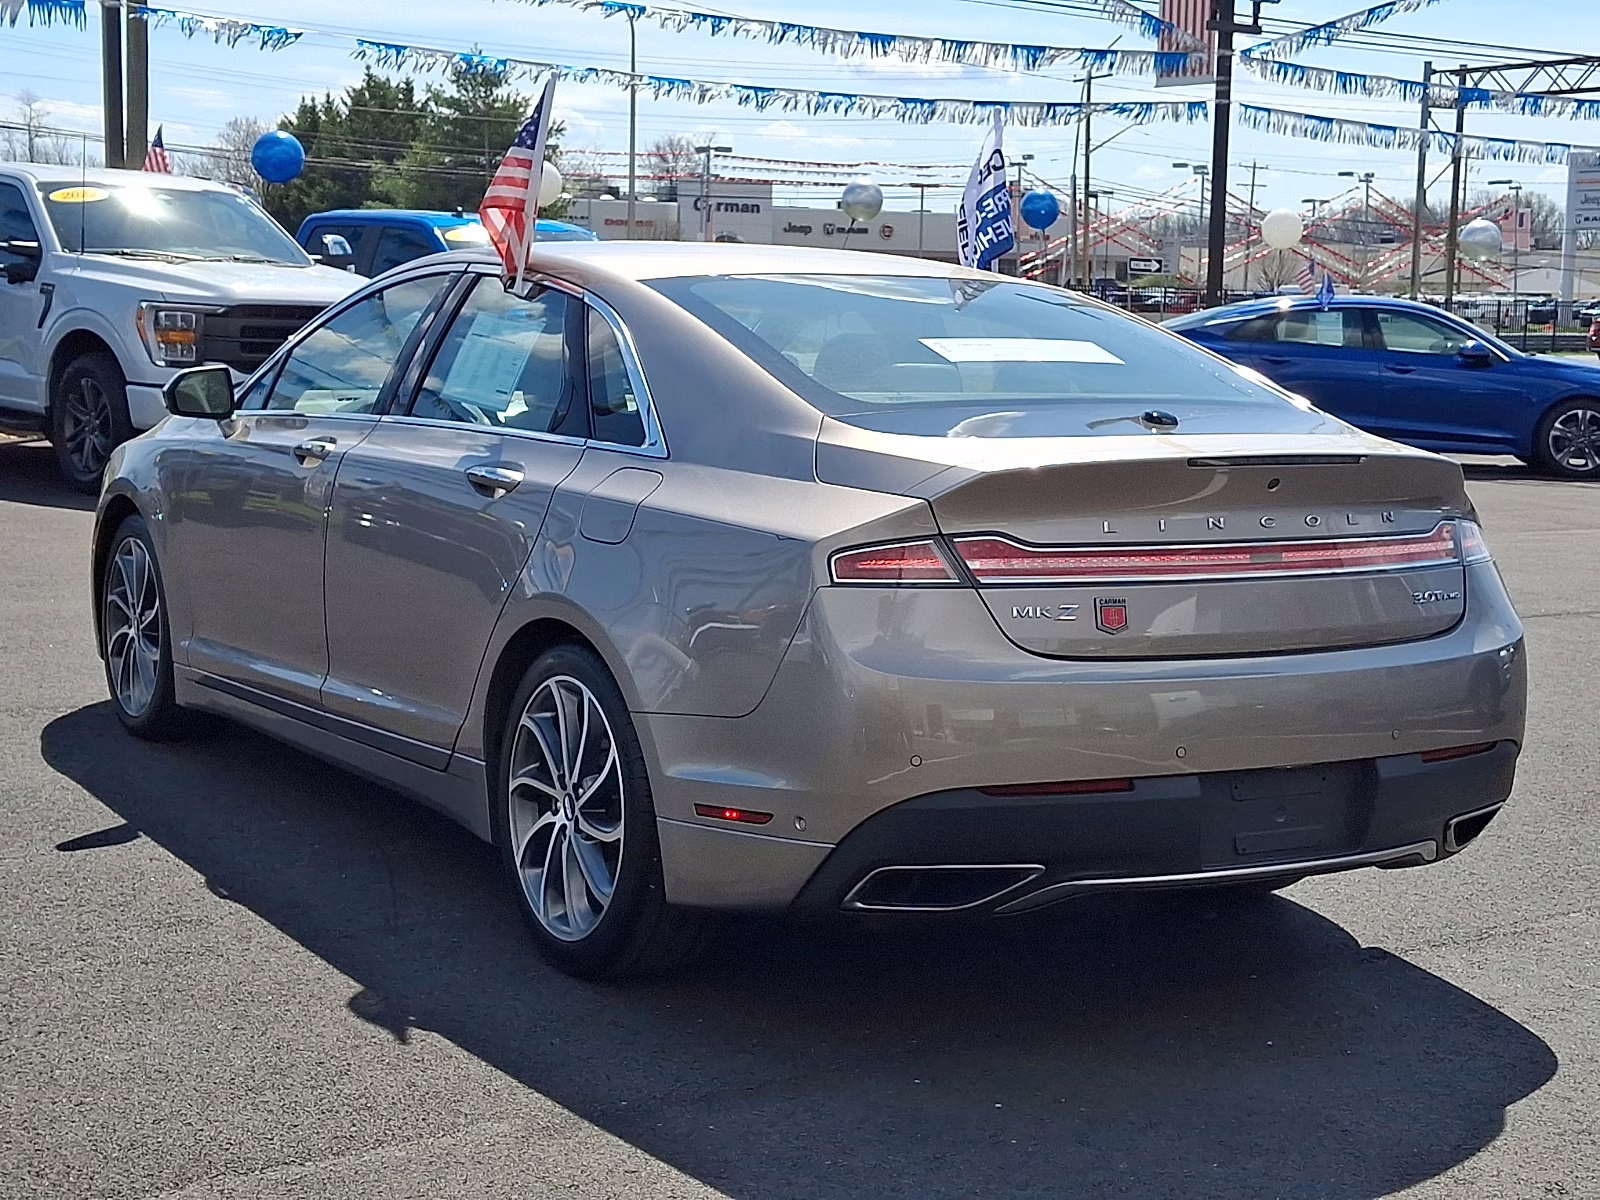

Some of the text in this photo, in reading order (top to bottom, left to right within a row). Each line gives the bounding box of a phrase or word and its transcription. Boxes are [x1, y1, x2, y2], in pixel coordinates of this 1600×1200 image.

[693, 197, 760, 213] Crman
[783, 222, 813, 236] Jeep
[1102, 510, 1395, 534] LINCOLN
[1011, 604, 1079, 621] MKZ
